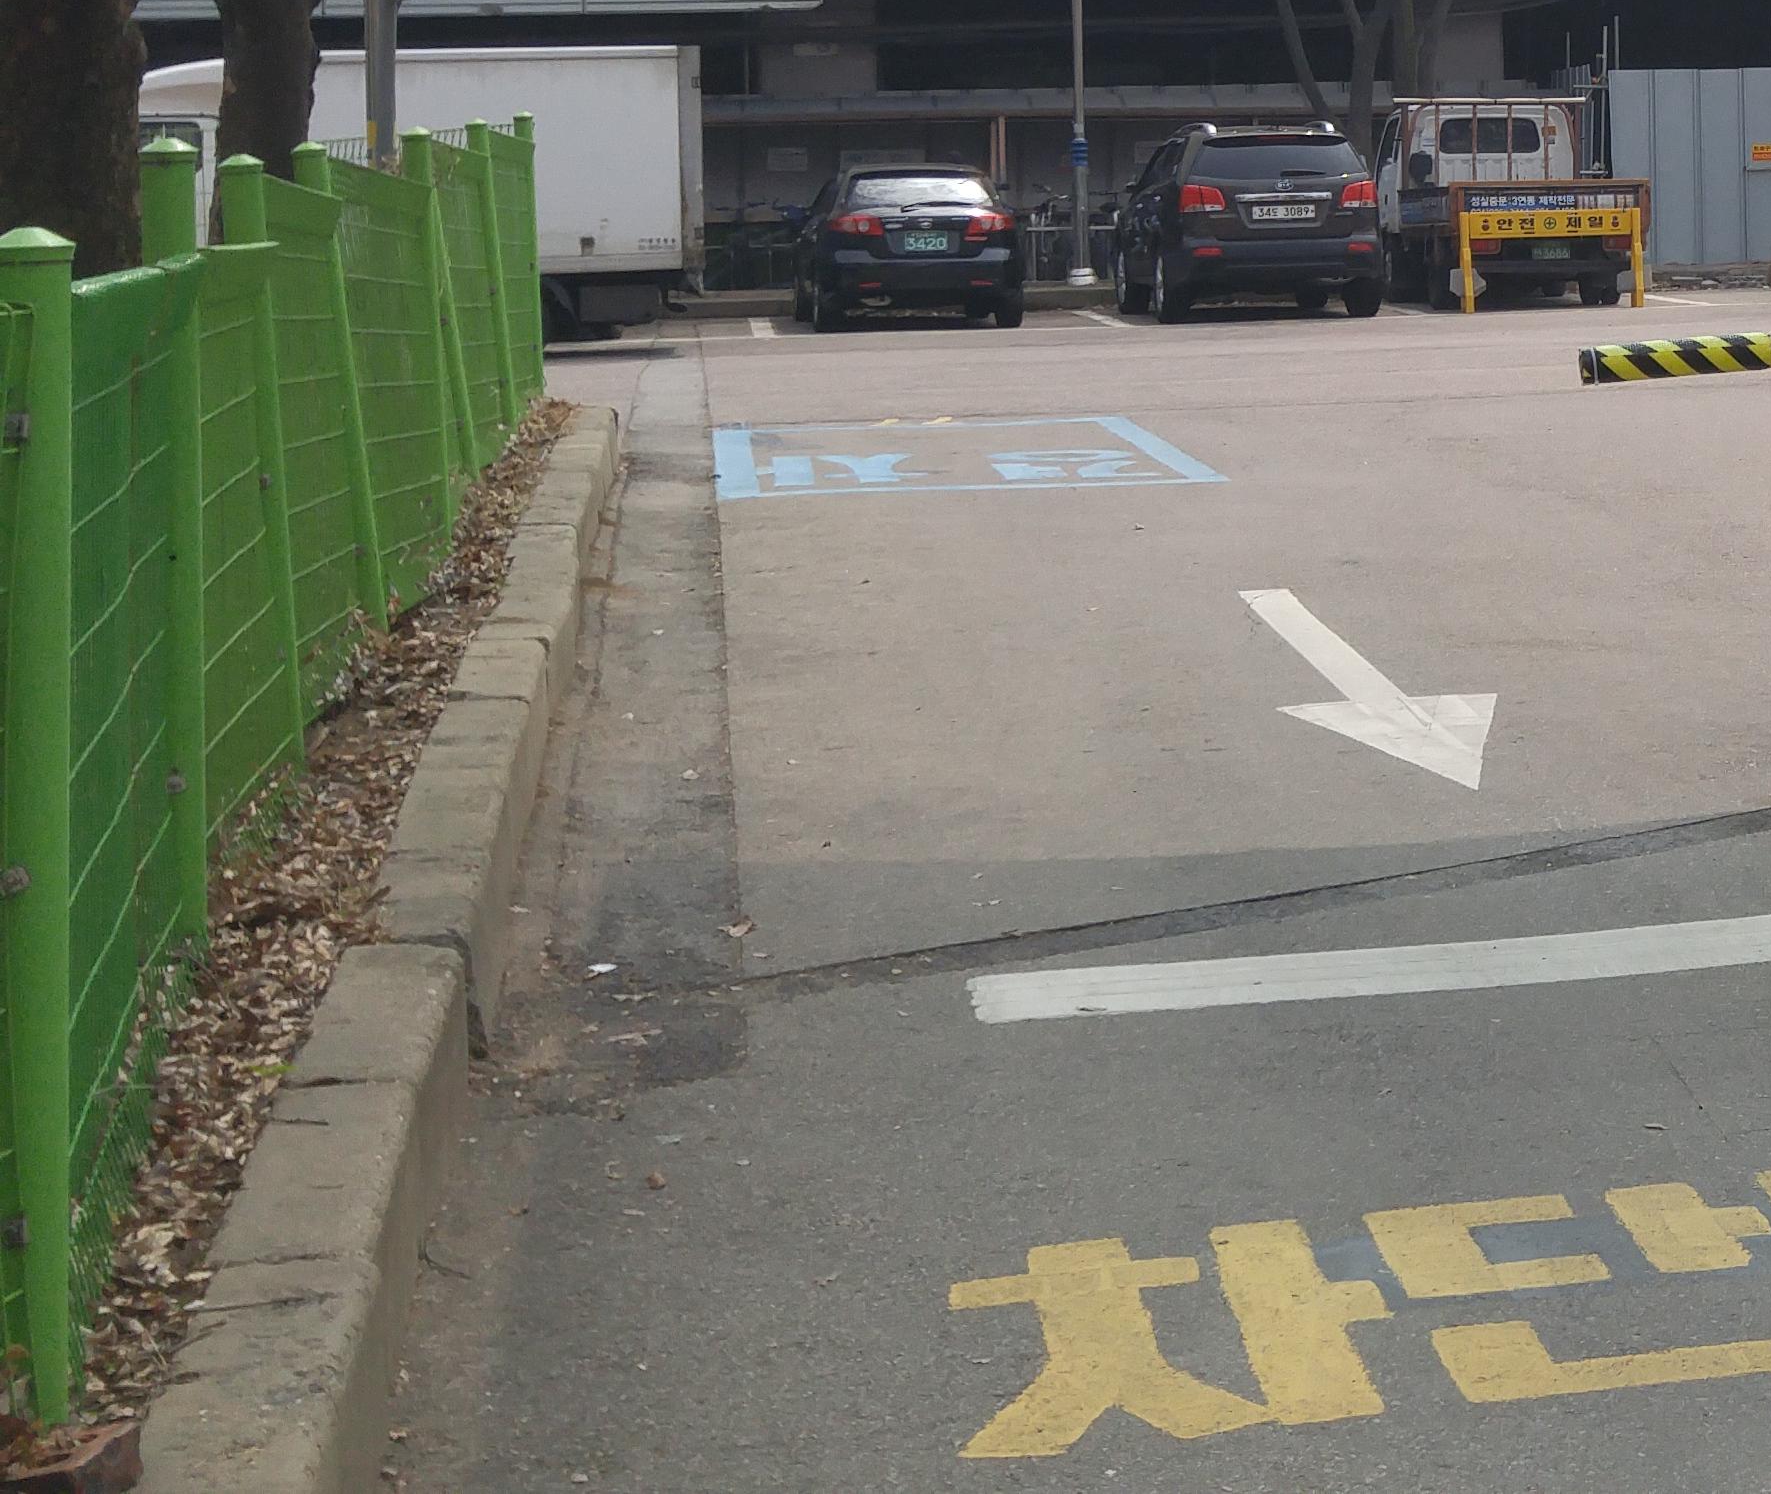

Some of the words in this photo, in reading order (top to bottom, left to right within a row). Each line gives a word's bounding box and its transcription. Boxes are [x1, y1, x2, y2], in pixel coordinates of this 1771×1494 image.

[1496, 217, 1536, 231] 안전
[1566, 215, 1604, 229] 제일
[905, 237, 947, 250] 3420
